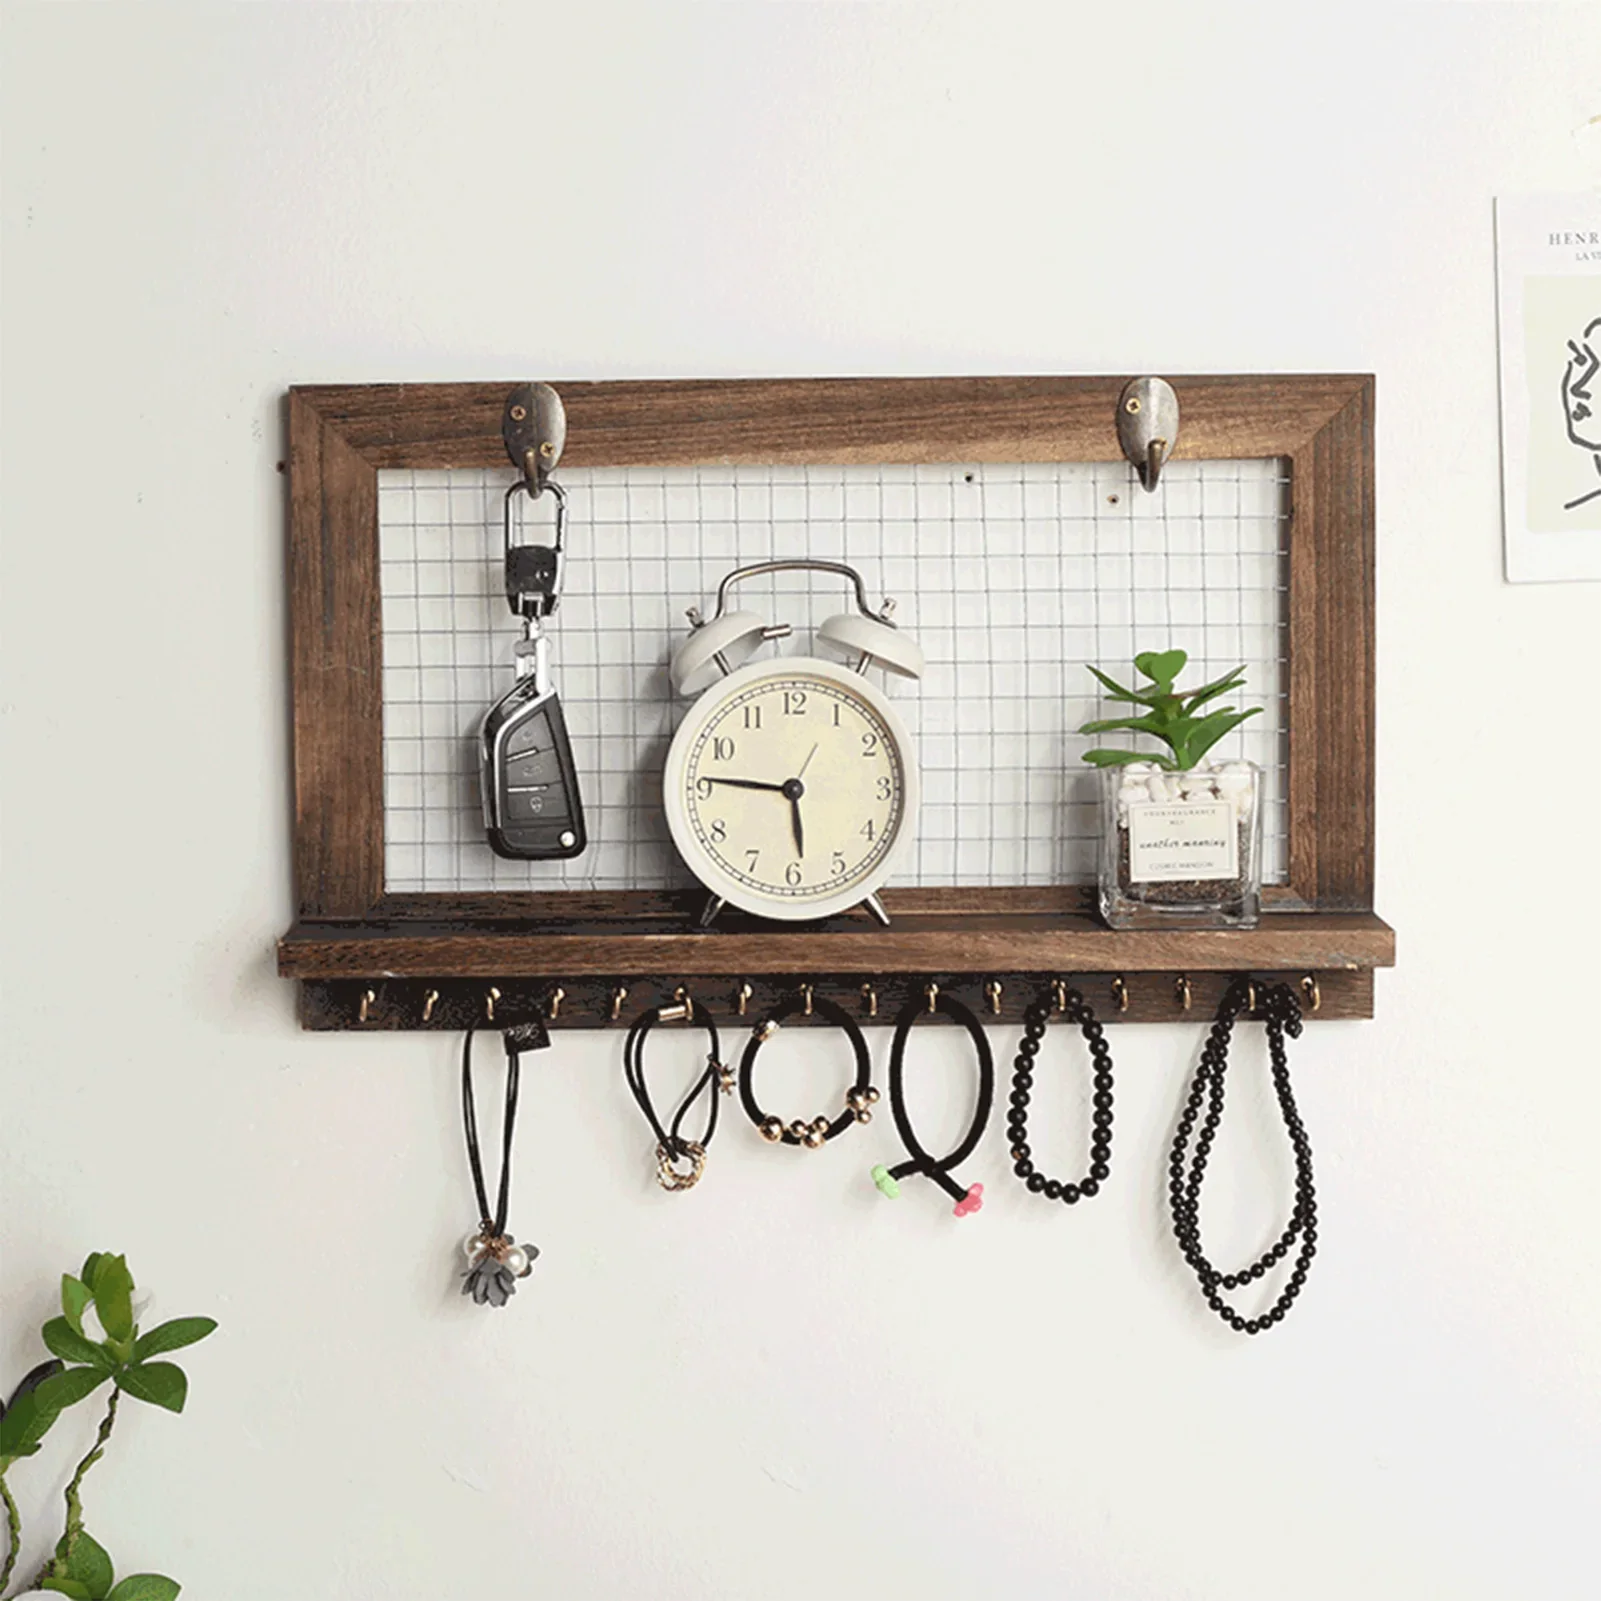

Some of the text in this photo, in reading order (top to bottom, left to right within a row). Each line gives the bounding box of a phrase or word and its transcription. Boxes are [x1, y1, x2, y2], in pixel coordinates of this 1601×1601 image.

[783, 691, 806, 715] 12
[743, 705, 761, 729] 11
[832, 704, 841, 726] 1
[712, 737, 735, 760] 10
[862, 734, 878, 757] 2
[696, 777, 712, 801] 9
[877, 777, 892, 801] 3
[710, 819, 727, 843] 8
[860, 819, 876, 842] 4
[744, 850, 760, 873] 7
[831, 851, 846, 875] 5
[786, 863, 801, 886] 6
